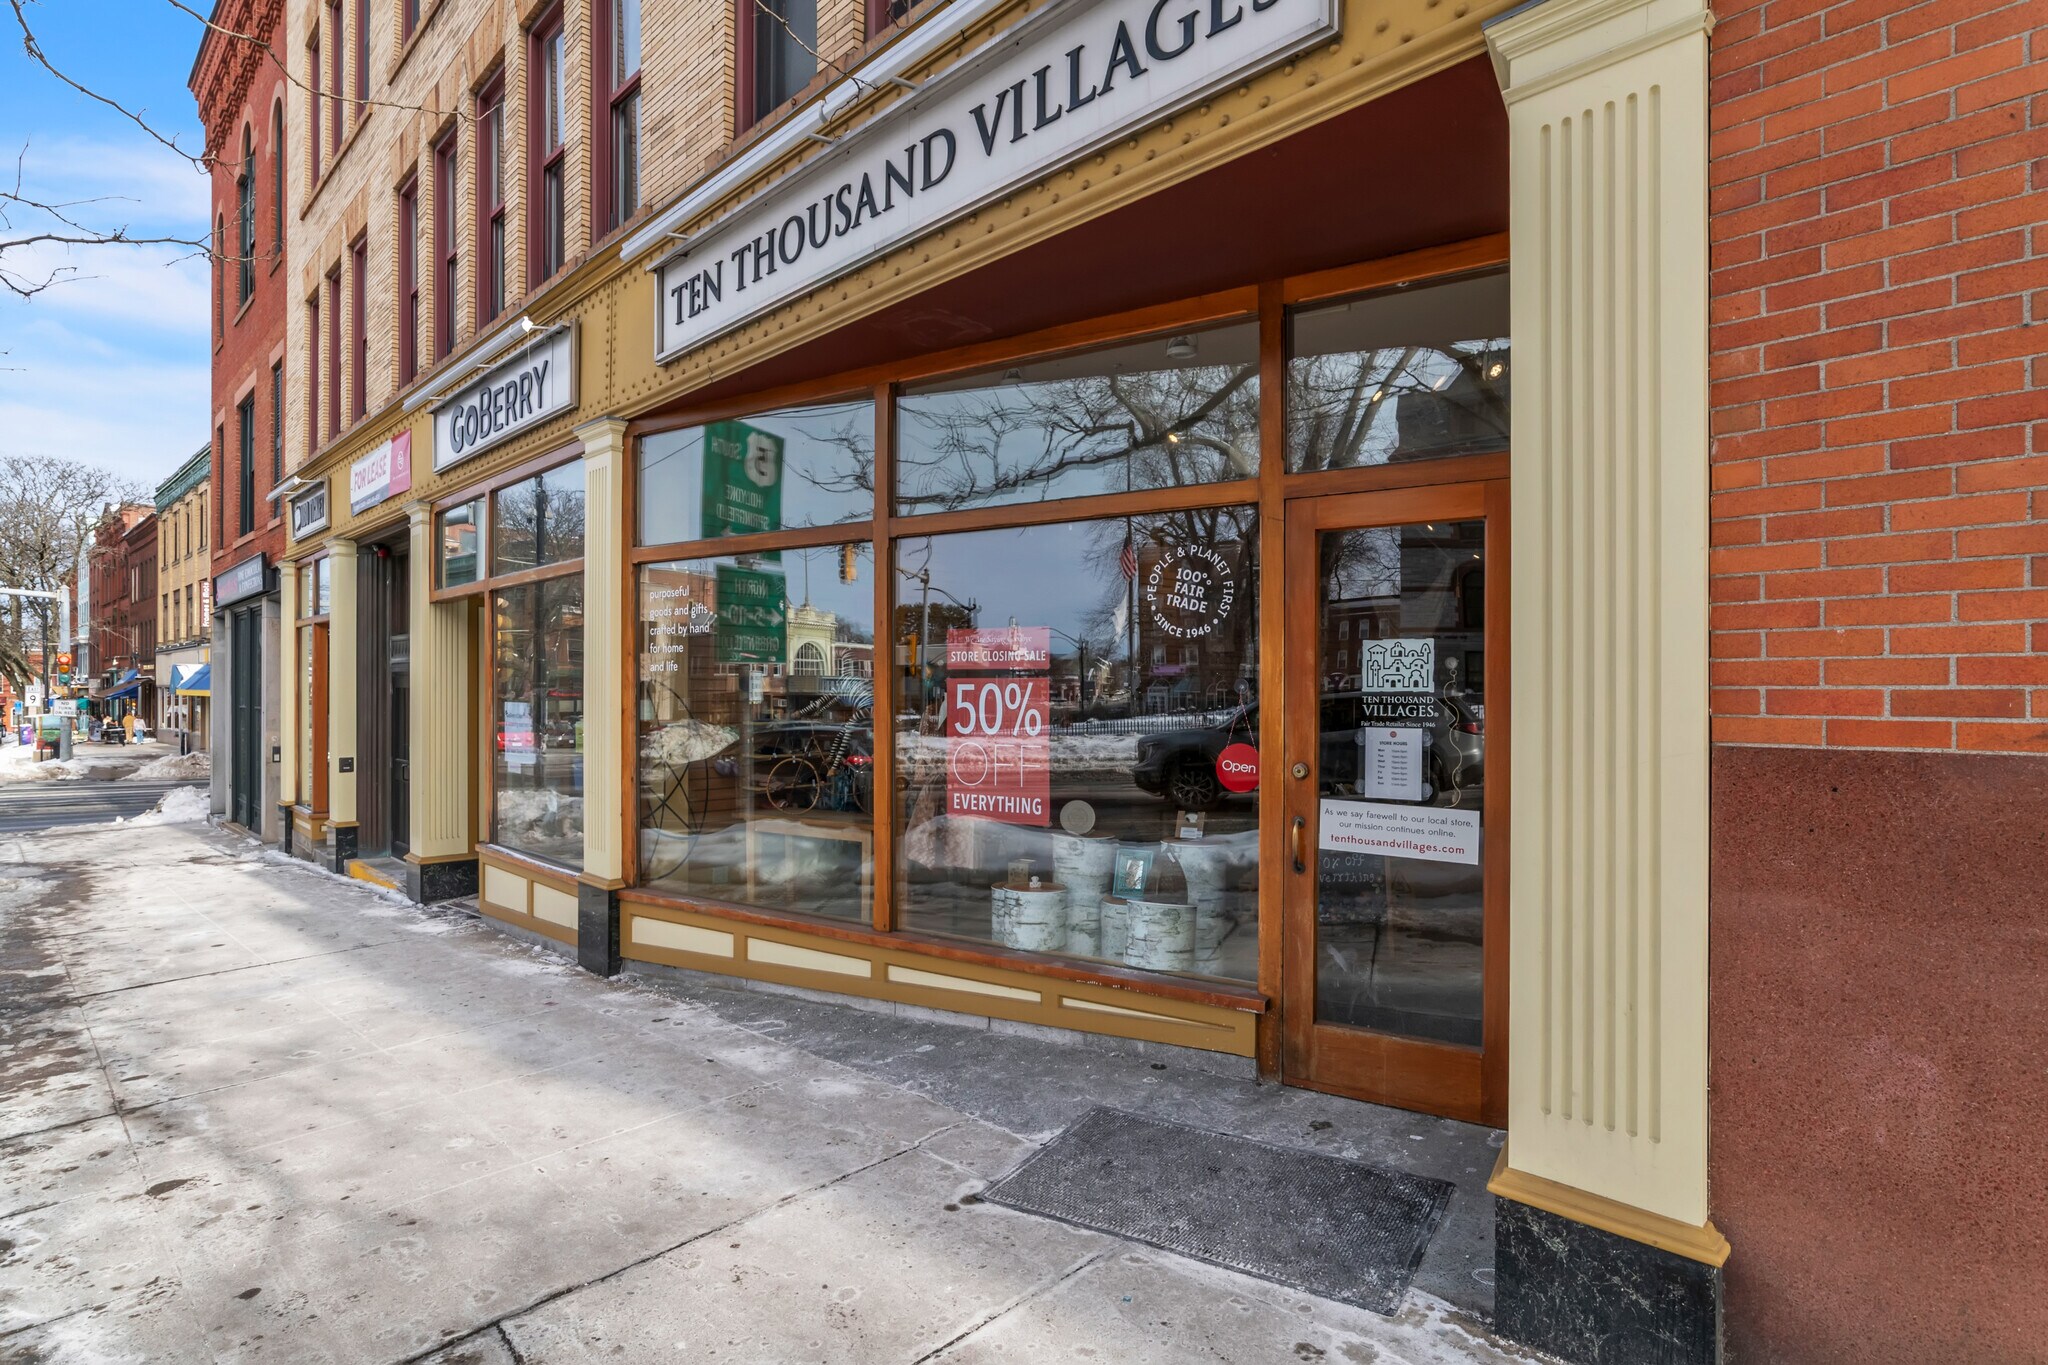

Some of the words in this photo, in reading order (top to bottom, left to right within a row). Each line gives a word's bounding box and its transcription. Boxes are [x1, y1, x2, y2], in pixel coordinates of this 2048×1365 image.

[671, 260, 723, 325] TEN
[731, 128, 957, 292] THOUSAND
[969, 0, 1278, 157] VILLAG
[354, 468, 366, 492] FOR
[367, 453, 387, 485] LEASE
[1147, 552, 1174, 601] PEOPLE
[1177, 546, 1186, 557] &
[1190, 544, 1231, 576] PLANET
[1217, 580, 1234, 618] FIRST
[1174, 581, 1205, 598] FAIR
[650, 585, 690, 602] purposeful
[649, 606, 672, 621] goods
[674, 604, 689, 616] and
[691, 603, 708, 619] gifts
[1166, 594, 1208, 613] TRADE
[650, 624, 676, 636] crafted
[677, 622, 688, 637] by
[689, 622, 710, 634] hand
[1154, 613, 1183, 637] SINCE
[1186, 624, 1211, 638] 1946
[650, 642, 660, 653] for
[662, 643, 684, 653] home
[951, 651, 979, 662] STORE
[981, 650, 1021, 662] CLOSING
[1024, 649, 1046, 661] SALE
[650, 660, 664, 671] and
[666, 659, 678, 671] life
[30, 695, 36, 704] 9
[1381, 696, 1434, 704] THOUSAND
[954, 682, 1042, 737] 50%
[953, 742, 1042, 788] OFF
[1222, 759, 1256, 774] Open
[953, 793, 1042, 815] EVERYTHING
[1324, 807, 1333, 816] As
[1350, 811, 1363, 820] say
[1366, 810, 1397, 821] farewell
[1400, 814, 1408, 822] to
[1427, 815, 1447, 825] local
[1354, 821, 1383, 831] mission
[1386, 825, 1425, 835] continues
[1427, 828, 1456, 838] online.
[1330, 833, 1465, 855] tenthousandvillages.com
[1323, 857, 1339, 869] 0%
[1320, 872, 1375, 883] verything
